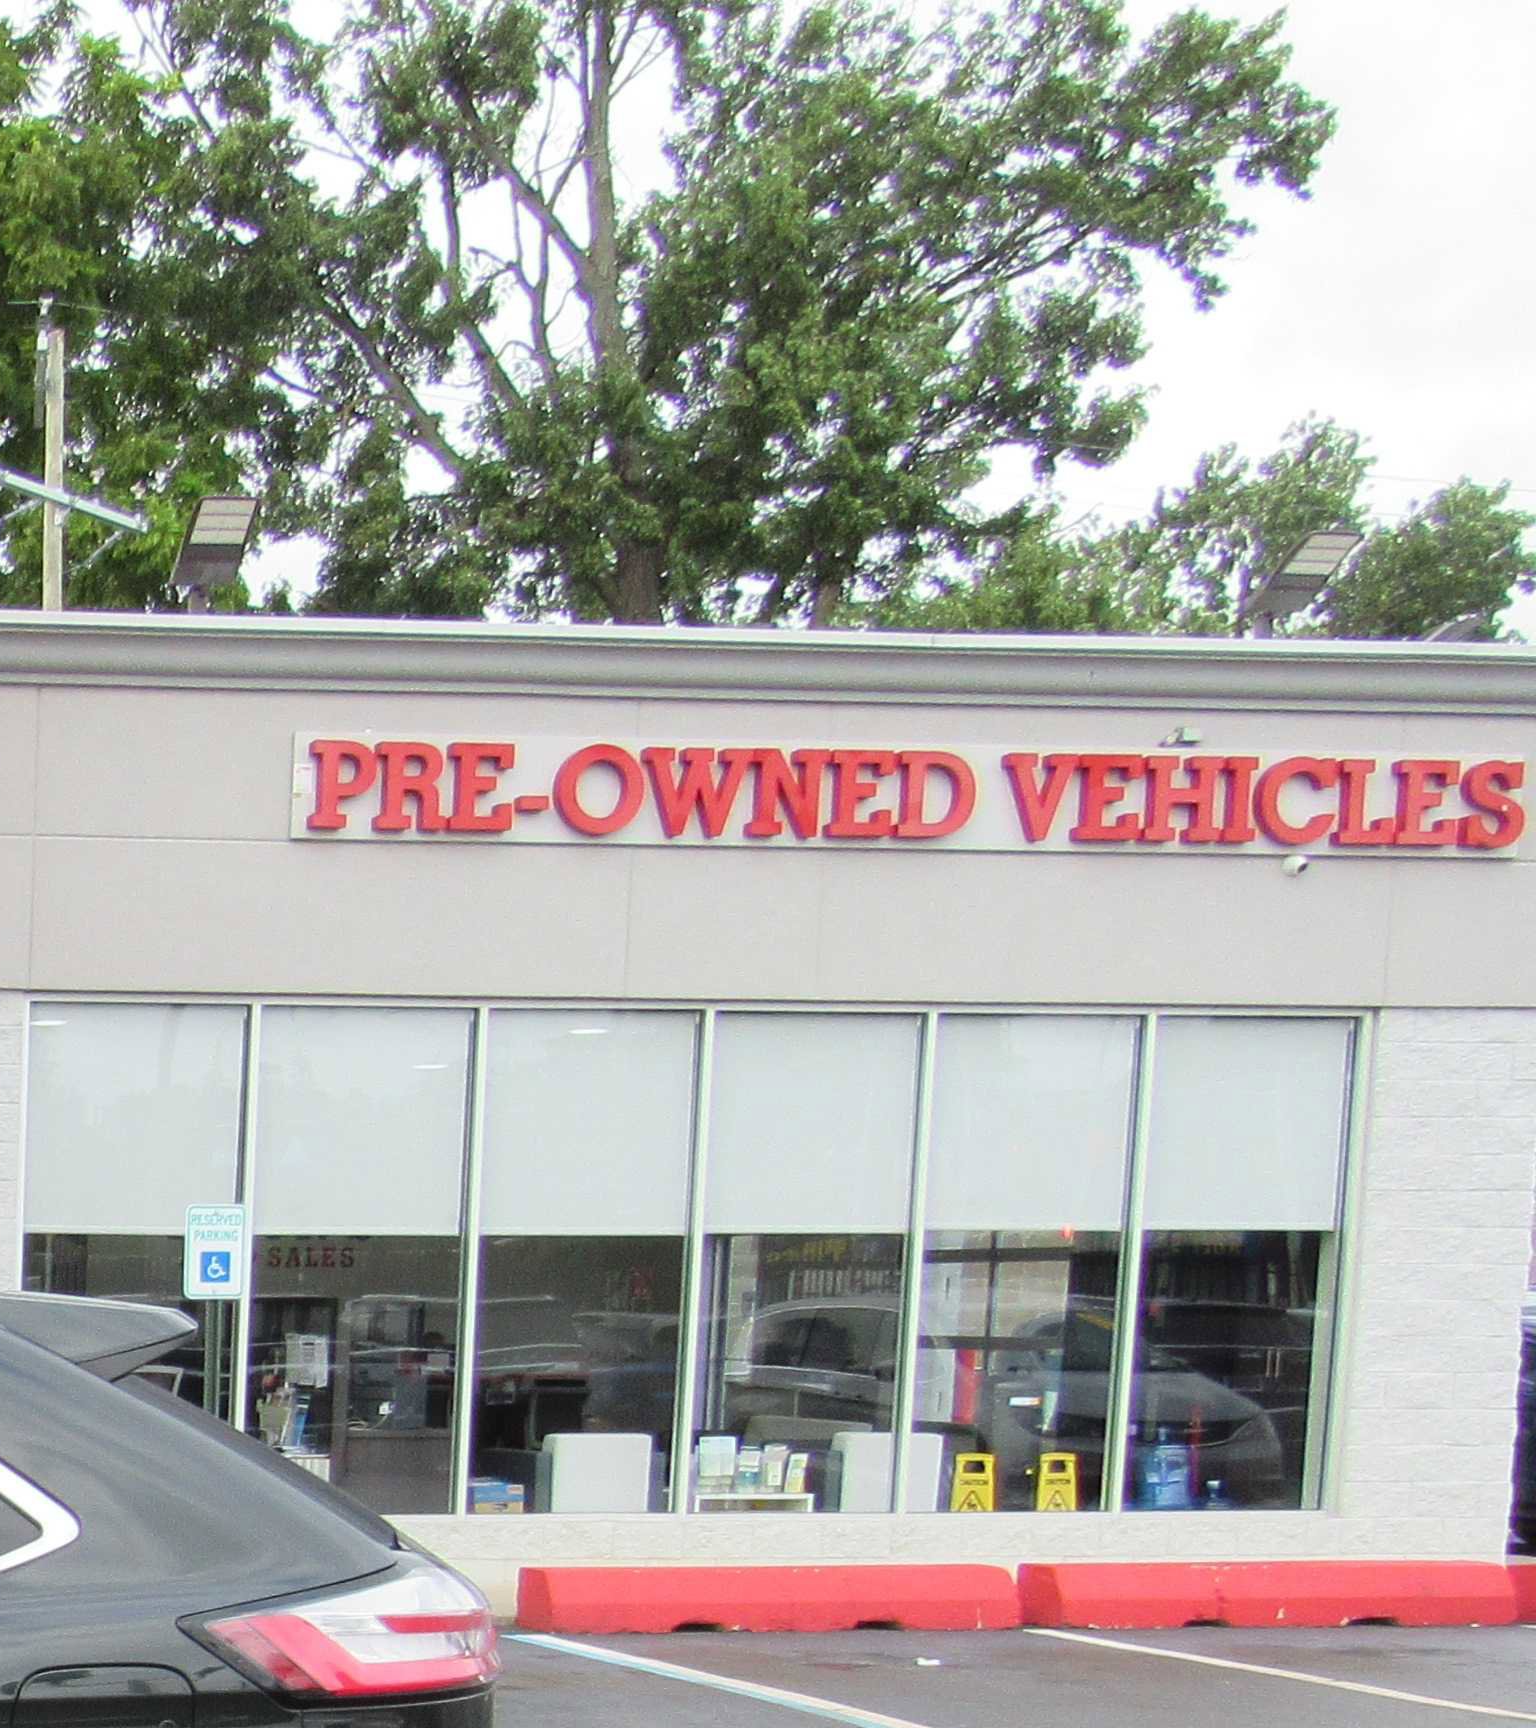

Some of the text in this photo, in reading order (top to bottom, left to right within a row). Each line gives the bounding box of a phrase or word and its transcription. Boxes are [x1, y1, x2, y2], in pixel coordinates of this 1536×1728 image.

[306, 739, 1526, 850] PRE-OWNED VEHICLES
[191, 1213, 243, 1227] RESERVED
[193, 1230, 239, 1243] PARKING
[268, 1246, 355, 1268] SALES
